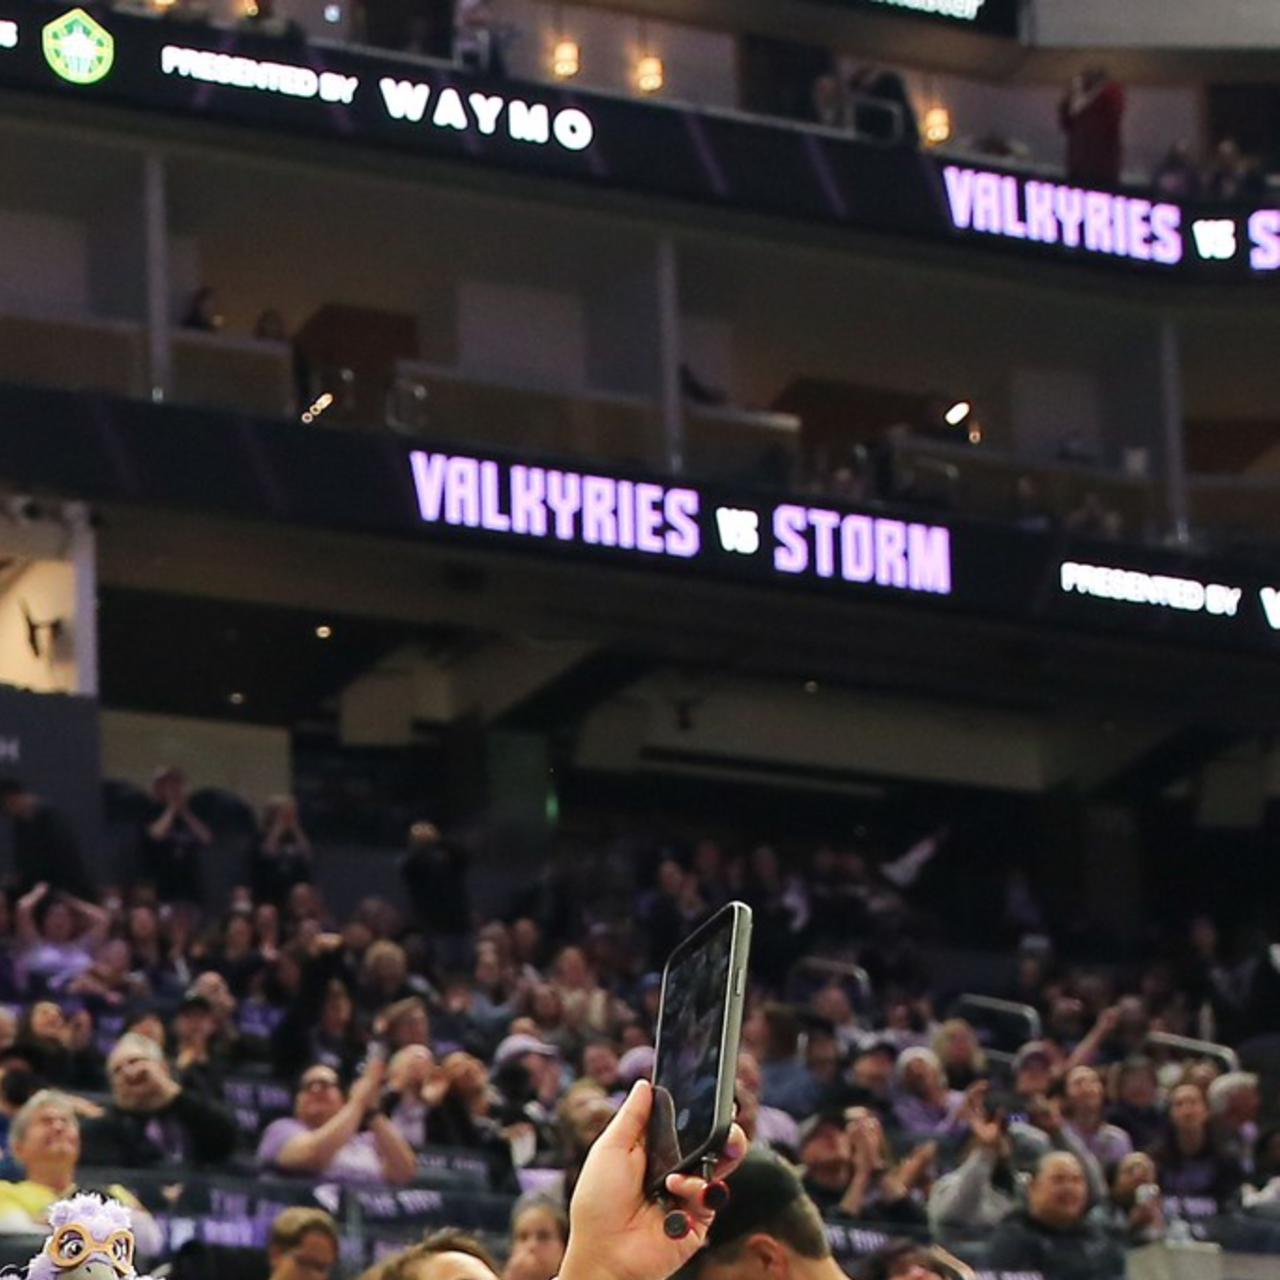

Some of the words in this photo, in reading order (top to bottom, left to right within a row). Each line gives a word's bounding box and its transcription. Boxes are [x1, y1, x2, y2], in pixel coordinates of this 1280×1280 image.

[161, 44, 318, 96] PRESENTED
[319, 71, 359, 104] BY
[379, 77, 594, 151] WAYMO
[942, 166, 1183, 265] VALKYRIES
[410, 450, 700, 558] VALKYRIES
[716, 506, 759, 556] VS
[772, 504, 952, 594] STORM
[1061, 561, 1205, 612] PRESENTED
[1203, 586, 1242, 616] BY
